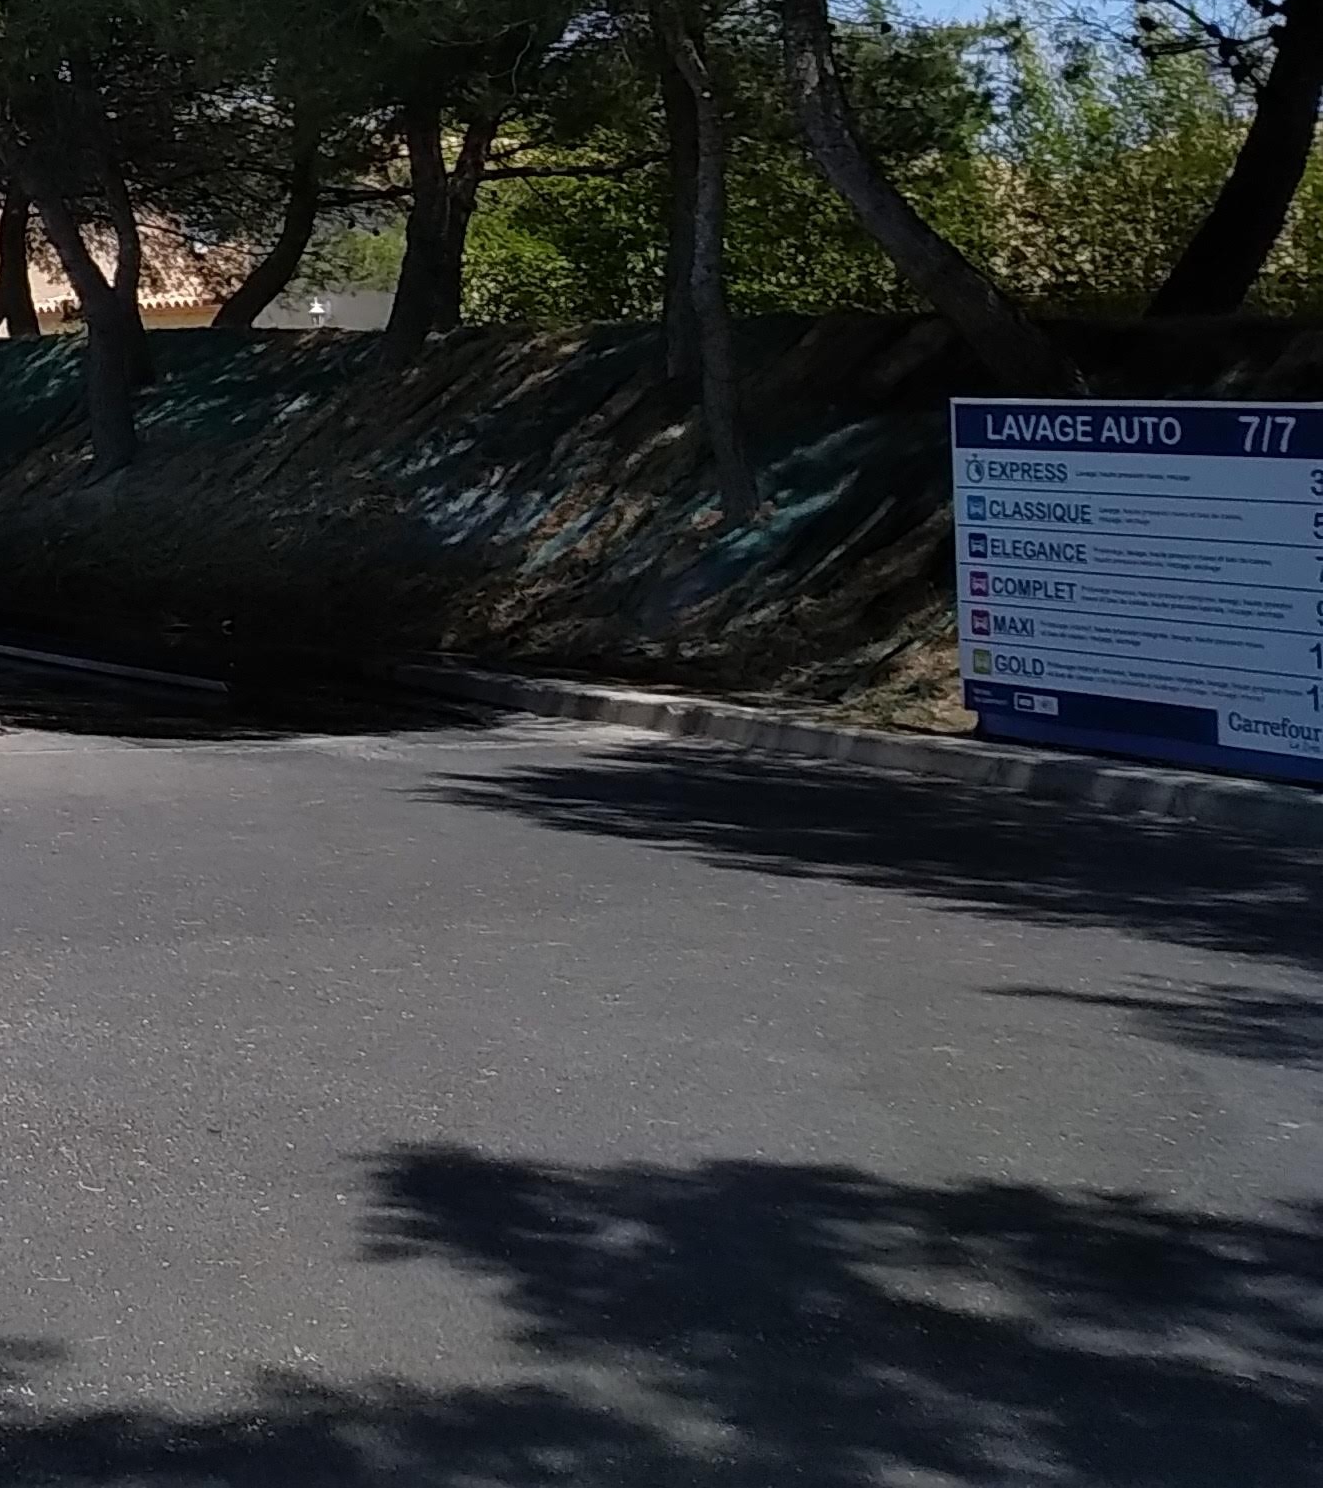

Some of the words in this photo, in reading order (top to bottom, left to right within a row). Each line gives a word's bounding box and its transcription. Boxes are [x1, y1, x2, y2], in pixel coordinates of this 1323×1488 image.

[986, 414, 1093, 442] LAVAGE
[1100, 416, 1182, 446] AUTO
[1238, 415, 1296, 453] 7/7
[988, 461, 1069, 482] EXPRESS
[989, 499, 1093, 524] CLASSIQUE
[990, 538, 1088, 562] ELEGANCE
[991, 576, 1078, 601] COMPLET
[993, 614, 1035, 636] MAXI
[995, 654, 1045, 676] GOLD
[1227, 711, 1323, 742] Carrefour
